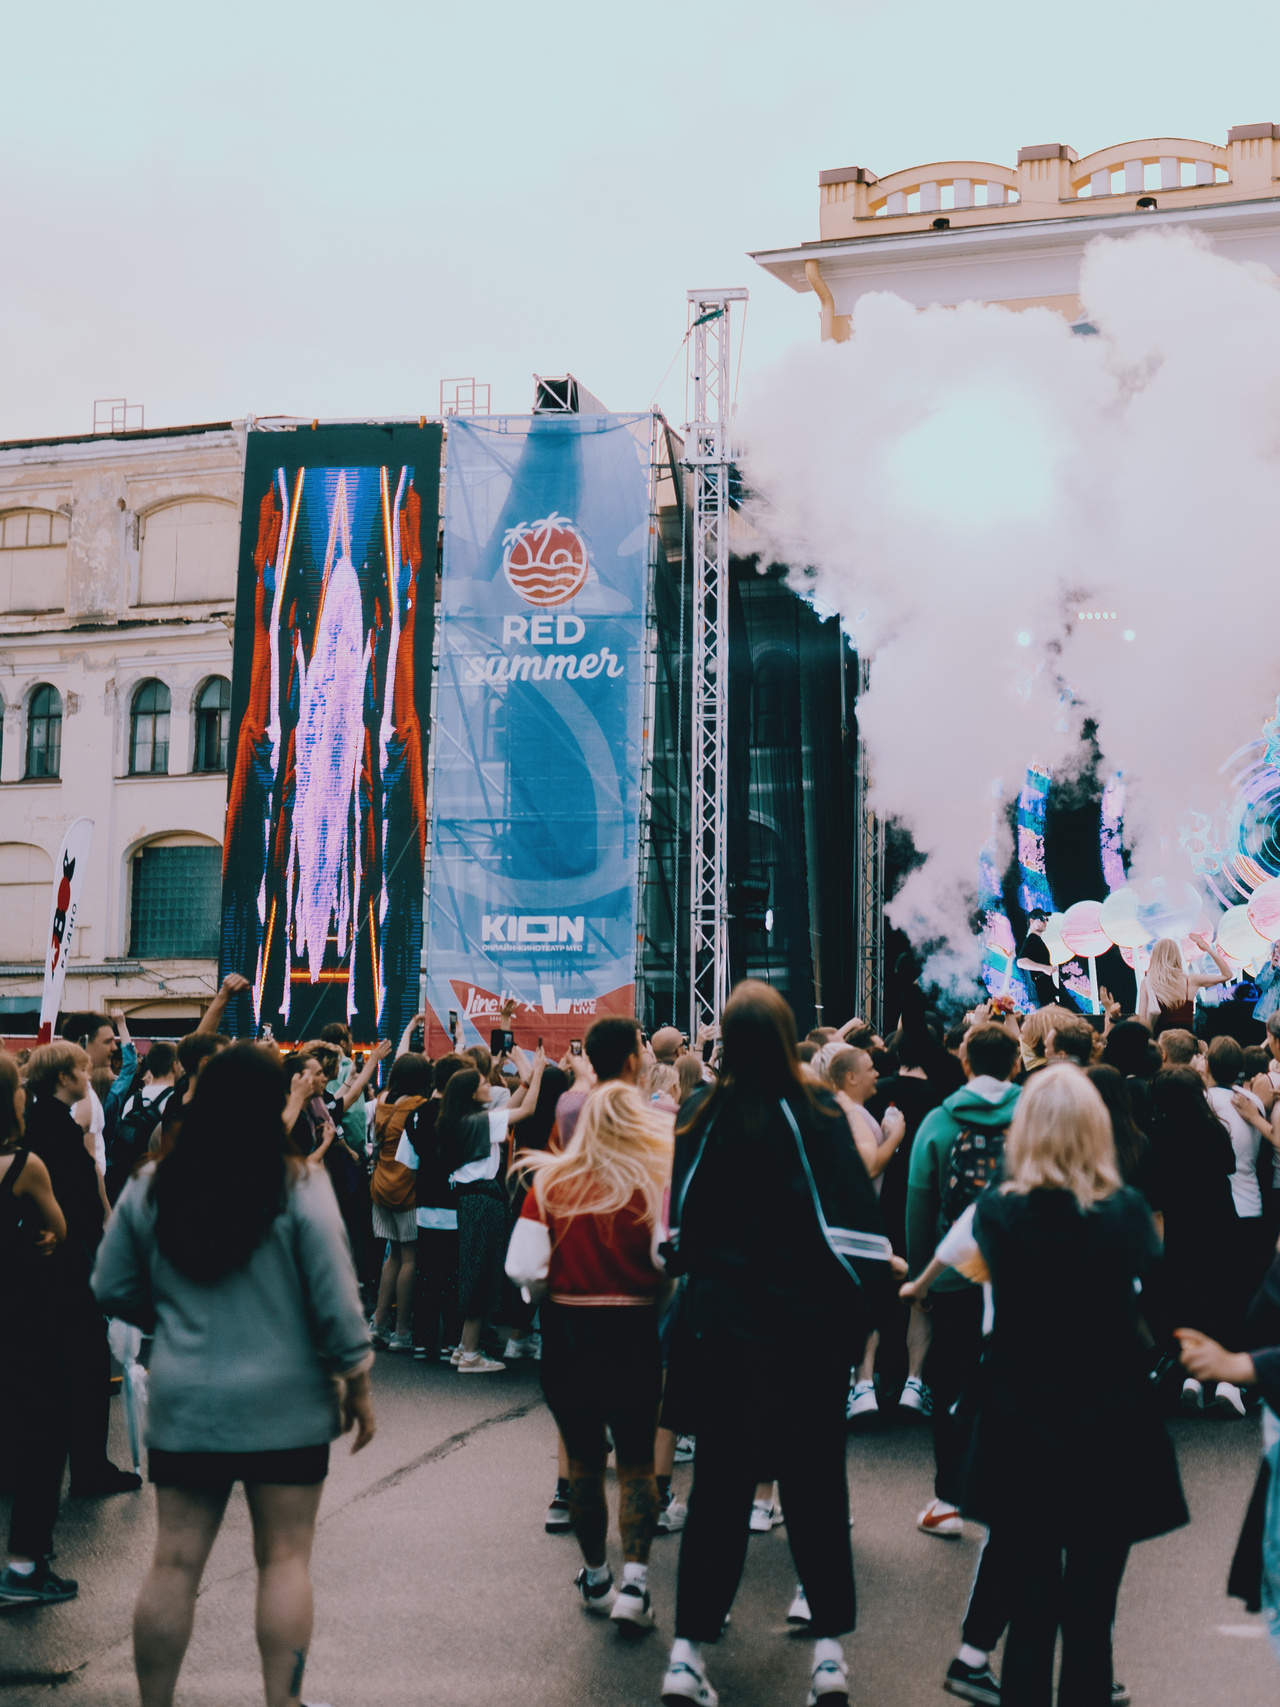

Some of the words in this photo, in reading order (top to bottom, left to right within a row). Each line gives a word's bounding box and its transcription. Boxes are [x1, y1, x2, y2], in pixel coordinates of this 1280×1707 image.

[503, 615, 586, 645] RED
[464, 647, 624, 682] summer
[481, 915, 585, 942] KION
[565, 944, 583, 952] МТС
[573, 998, 596, 1007] МТС
[573, 1006, 596, 1015] LIVE
